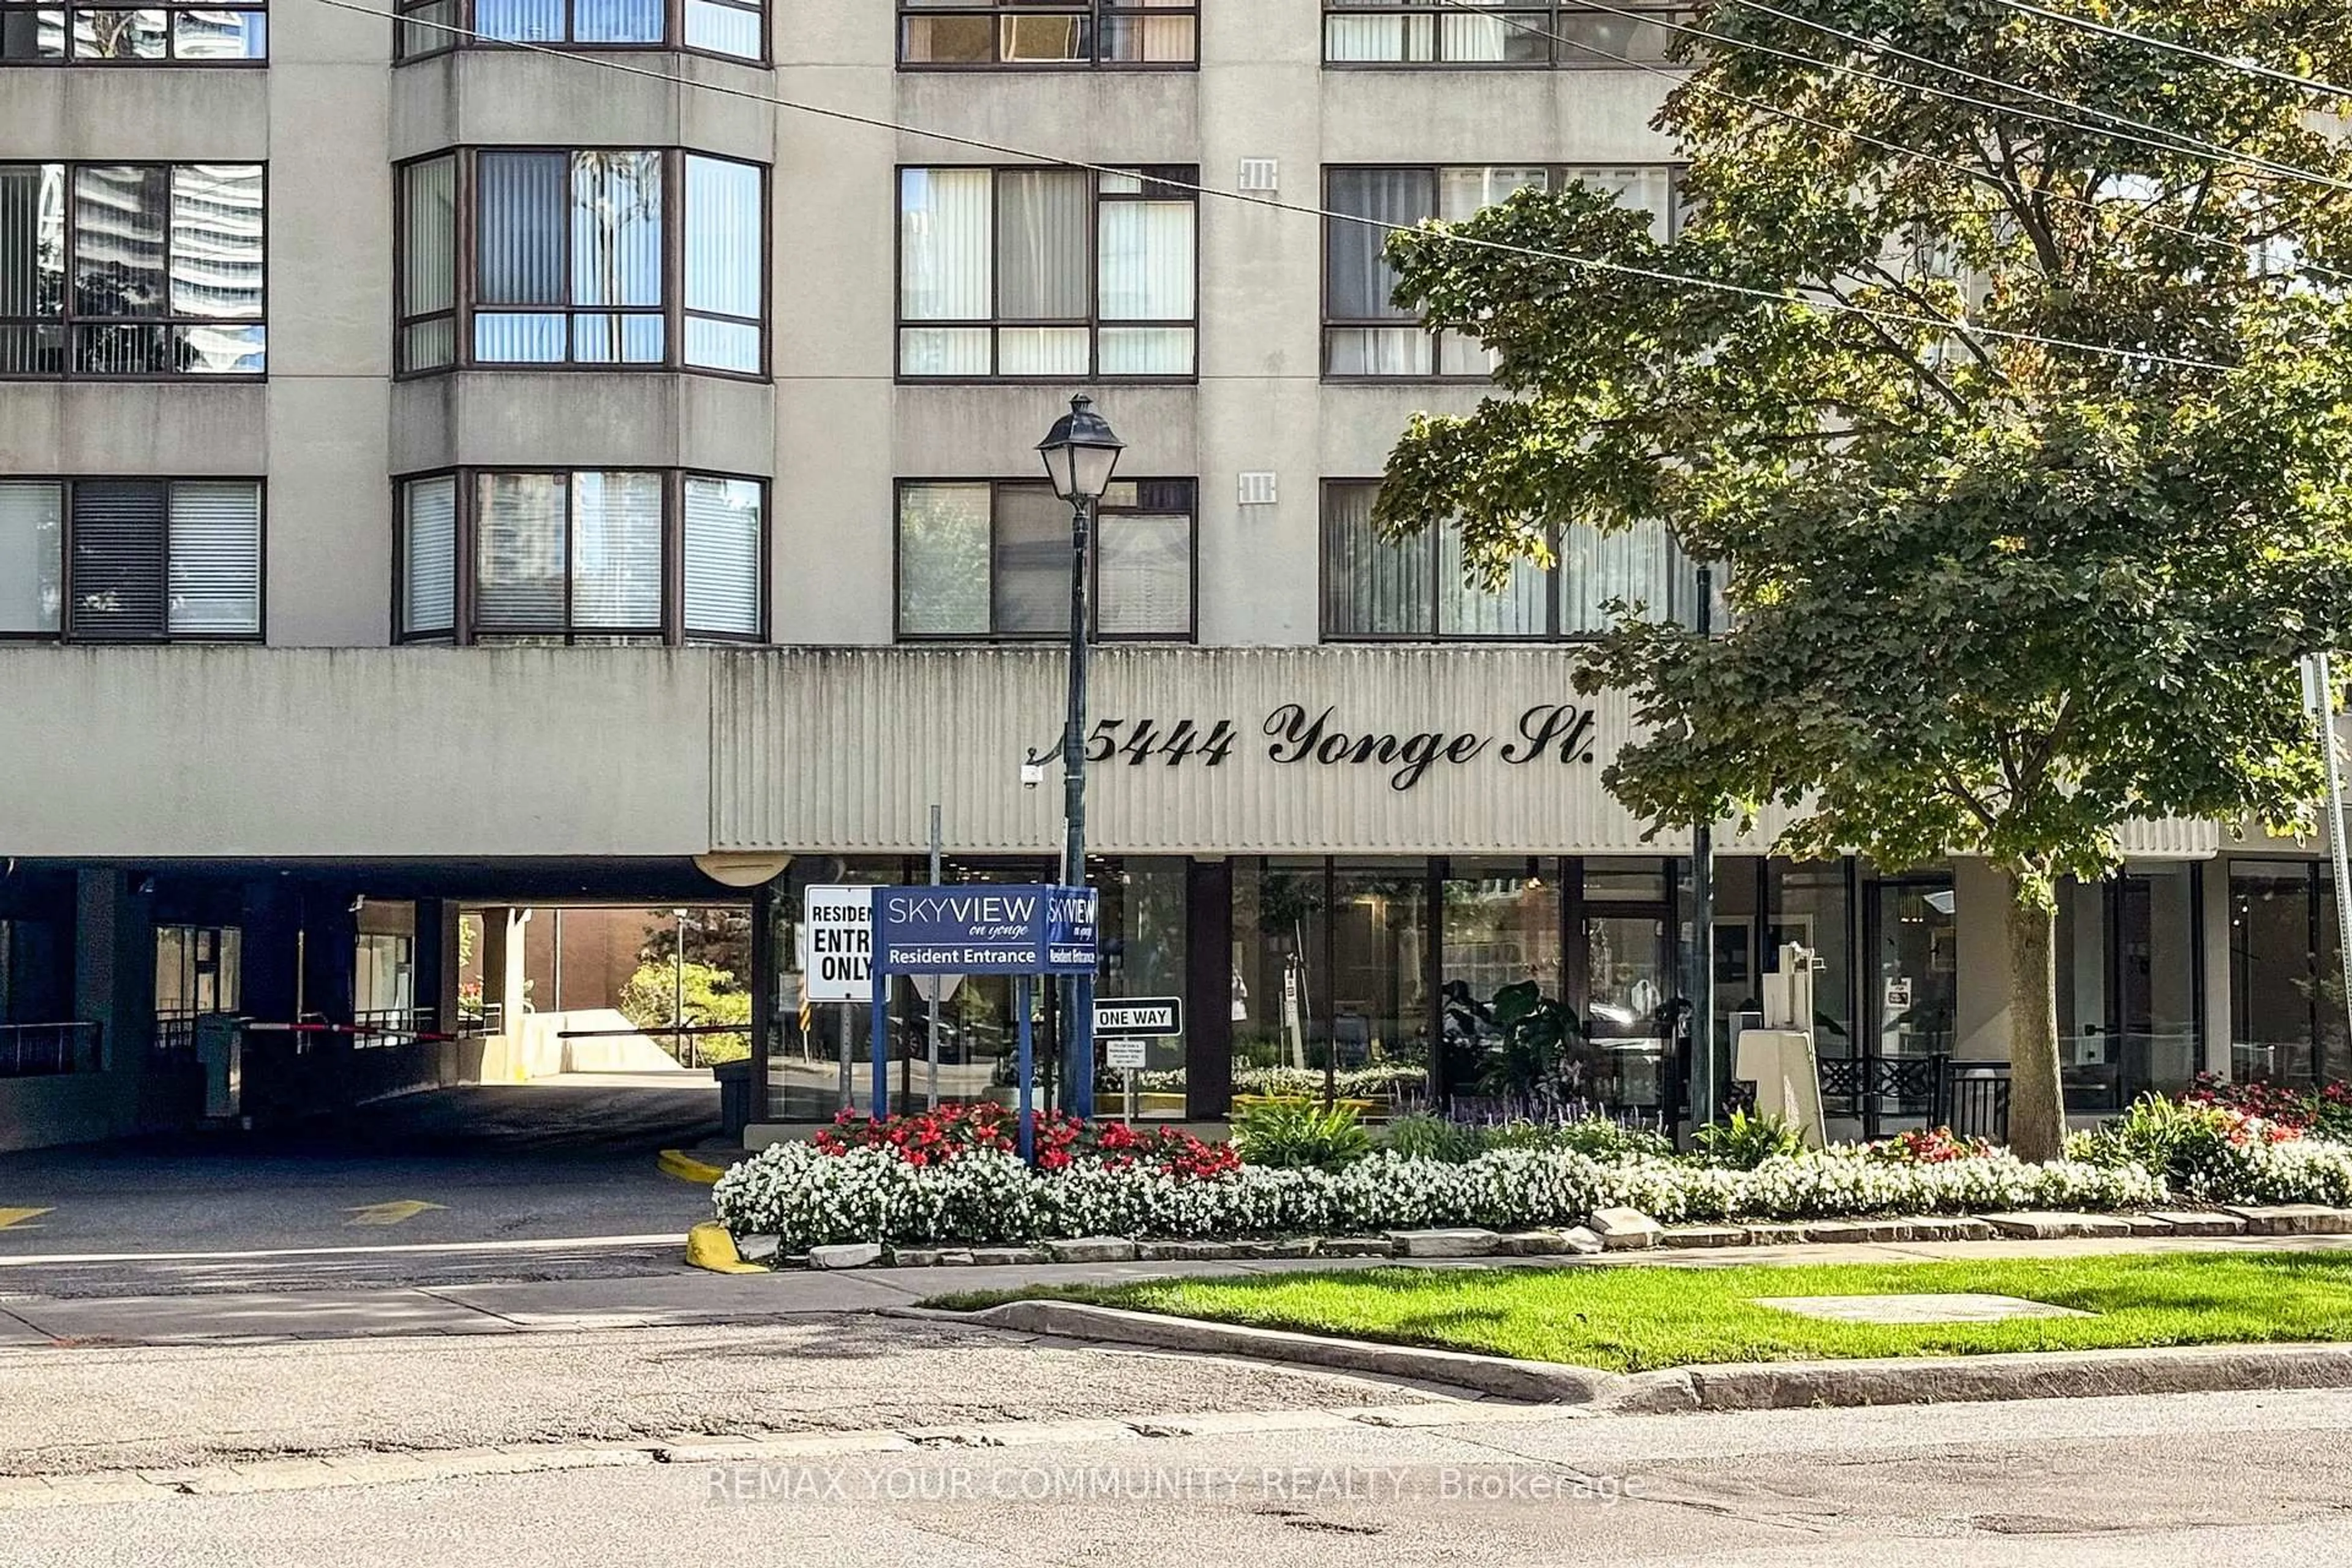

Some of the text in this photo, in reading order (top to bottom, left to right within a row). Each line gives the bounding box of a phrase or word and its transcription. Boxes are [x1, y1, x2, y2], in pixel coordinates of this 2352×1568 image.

[1085, 703, 1596, 791] 5444 Yonge St.
[813, 906, 873, 922] RESIDEN
[889, 897, 1036, 923] SKYVIEW
[1048, 897, 1095, 924] SKYVIEW
[814, 929, 870, 952] ENTR
[969, 924, 1030, 940] on yonge
[889, 949, 1036, 963] Resident Entrance
[822, 957, 873, 981] ONLY
[1099, 1010, 1167, 1025] ONE WAY
